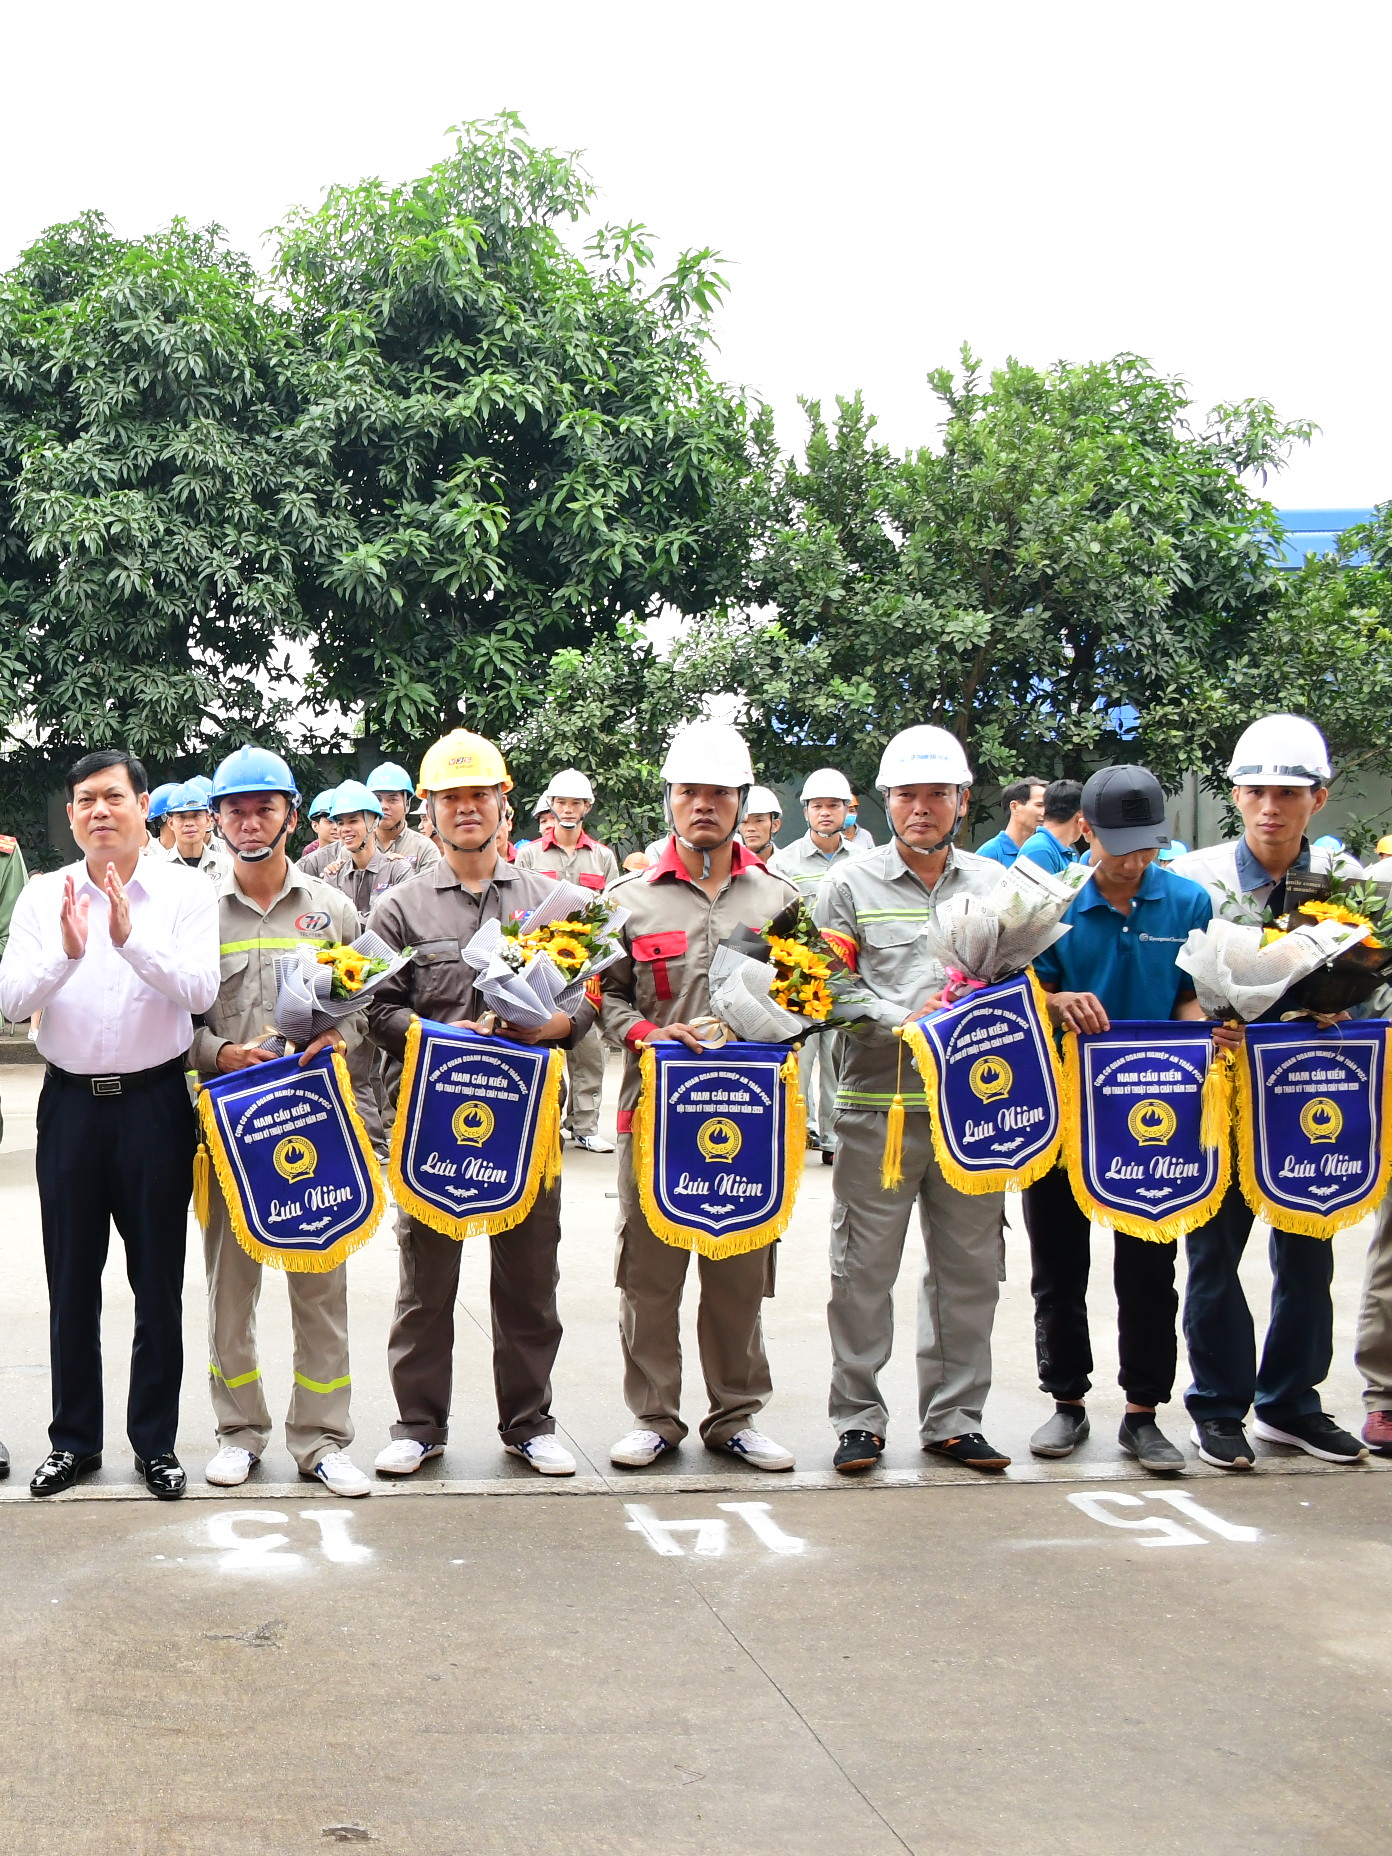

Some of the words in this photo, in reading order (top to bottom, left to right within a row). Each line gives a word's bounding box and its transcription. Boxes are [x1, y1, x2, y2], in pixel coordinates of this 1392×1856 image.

[451, 1072, 471, 1083] NAM
[1117, 1073, 1138, 1082] NAM
[1289, 1071, 1309, 1081] NAM
[691, 1091, 710, 1101] NAM
[253, 1115, 273, 1128] NAM
[963, 1120, 996, 1145] Lưu
[998, 1106, 1045, 1131] Niệm
[420, 1152, 457, 1177] Lưu
[462, 1157, 507, 1187] Niệm
[1105, 1156, 1145, 1180] Lưu
[1150, 1156, 1200, 1184] Niệm
[1279, 1155, 1316, 1178] Lưu
[1320, 1154, 1362, 1181] Niệm
[674, 1172, 709, 1195] Lưu
[714, 1173, 763, 1202] Niệm
[268, 1200, 303, 1224] Lưu
[305, 1185, 353, 1211] Niệm
[624, 1500, 806, 1558] 14
[1067, 1488, 1259, 1547] 15
[207, 1509, 373, 1570] 13
